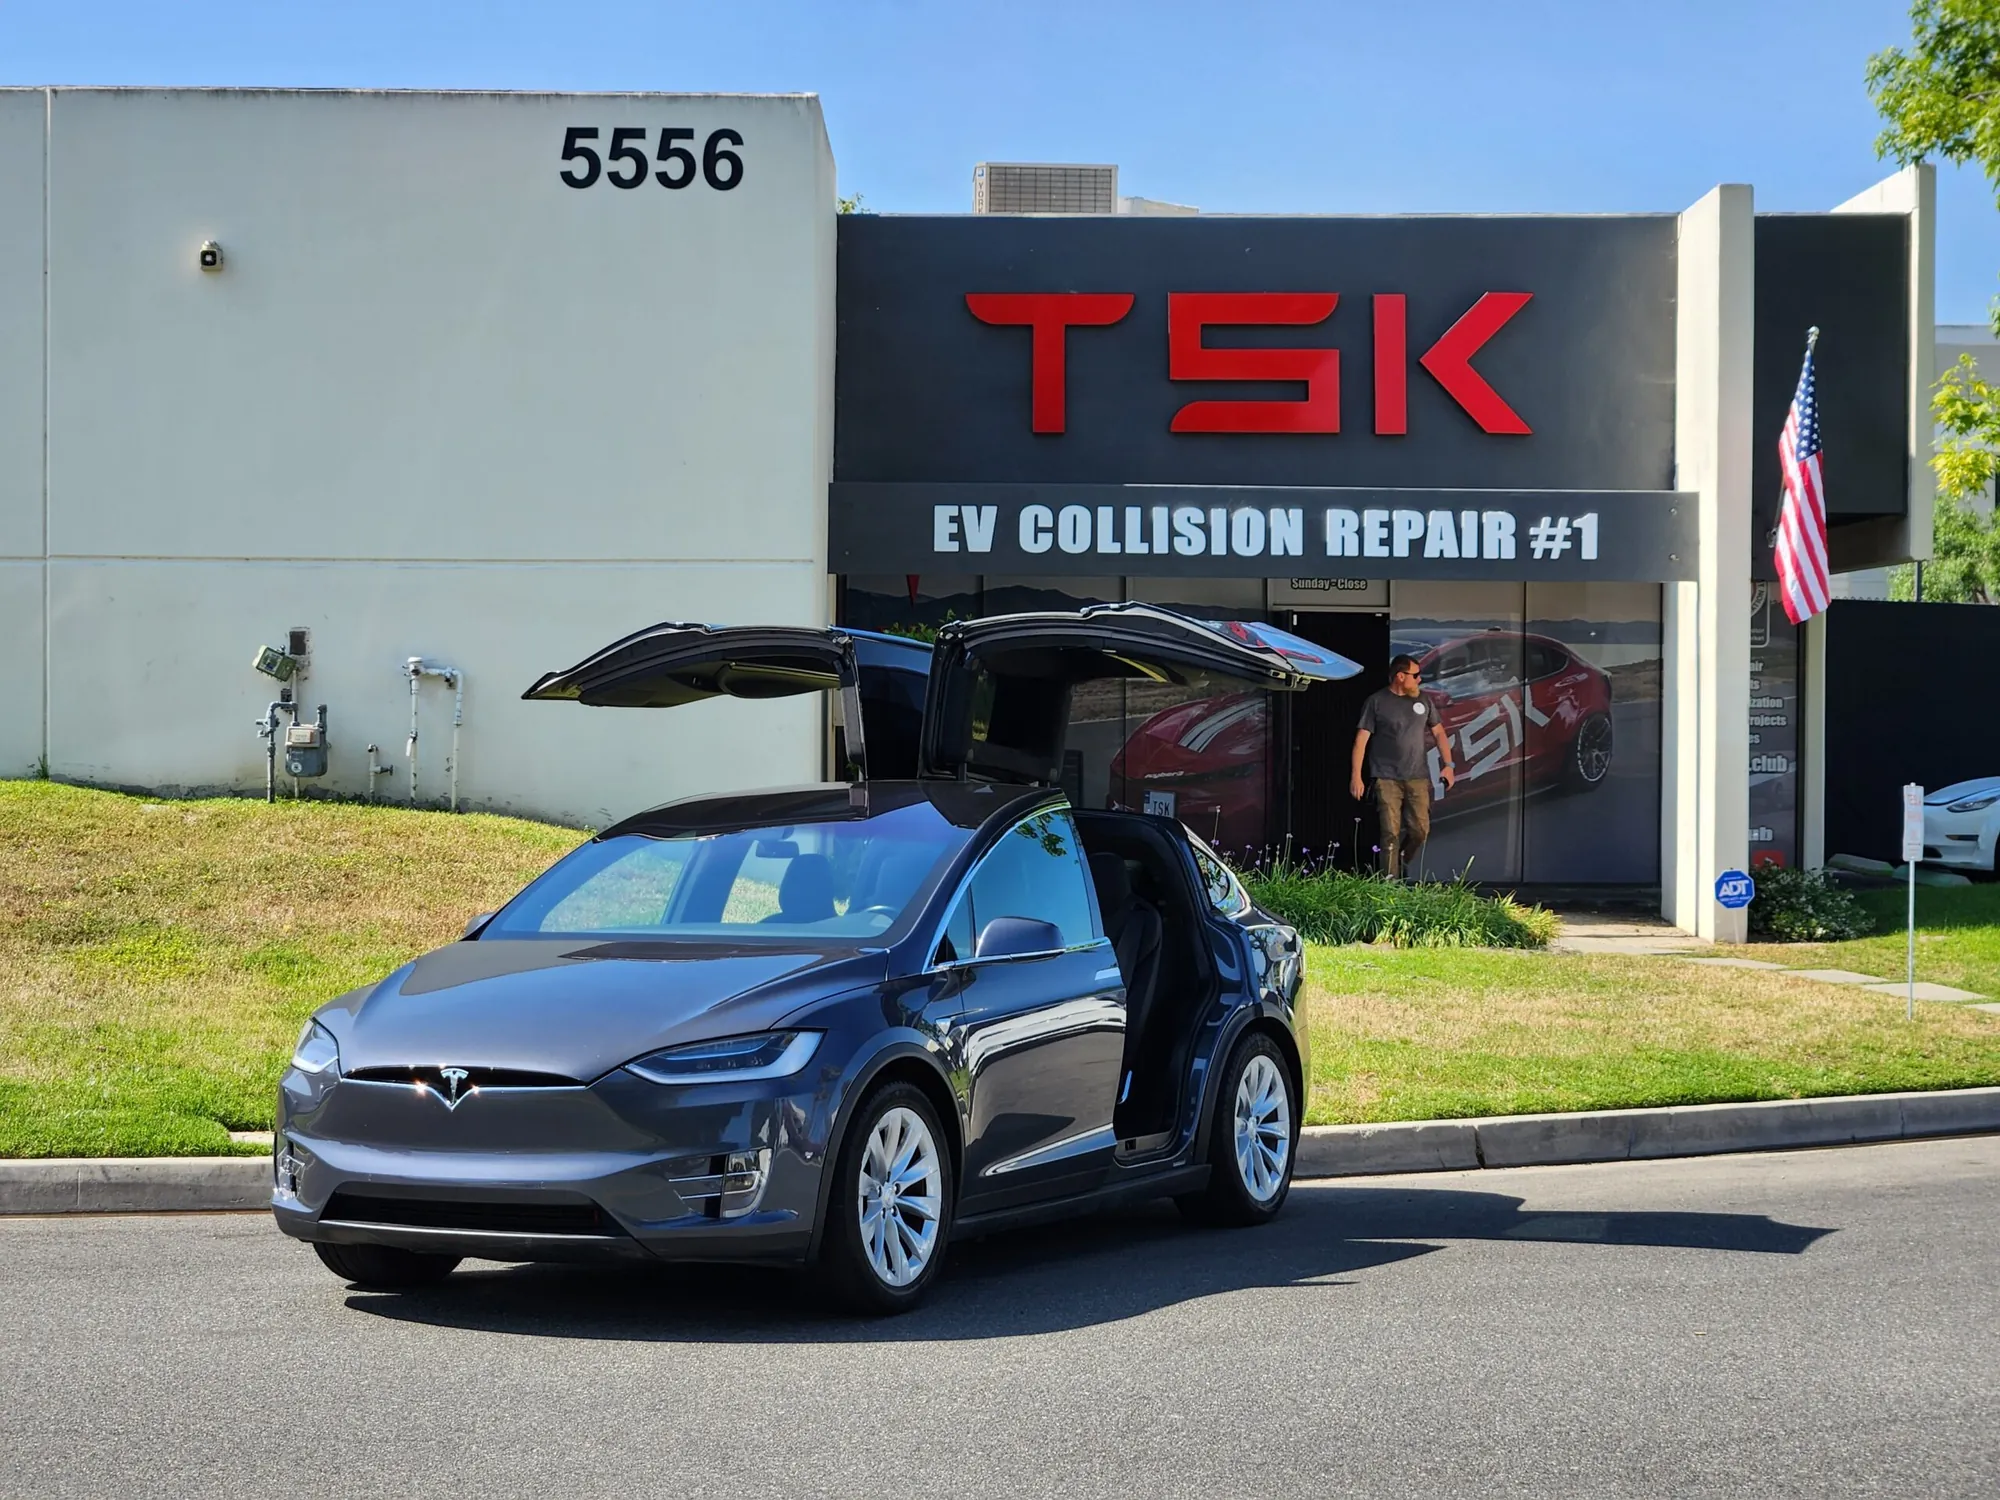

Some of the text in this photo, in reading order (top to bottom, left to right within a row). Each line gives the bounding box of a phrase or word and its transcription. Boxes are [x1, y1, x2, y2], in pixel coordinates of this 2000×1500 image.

[559, 126, 744, 191] 5556
[965, 291, 1534, 435] TSK
[934, 504, 1598, 560] EV COLLISION REPAIR #1
[1291, 577, 1330, 591] Sunday
[1337, 578, 1367, 590] Close
[1750, 715, 1787, 727] rojects
[1718, 879, 1749, 897] ADT
